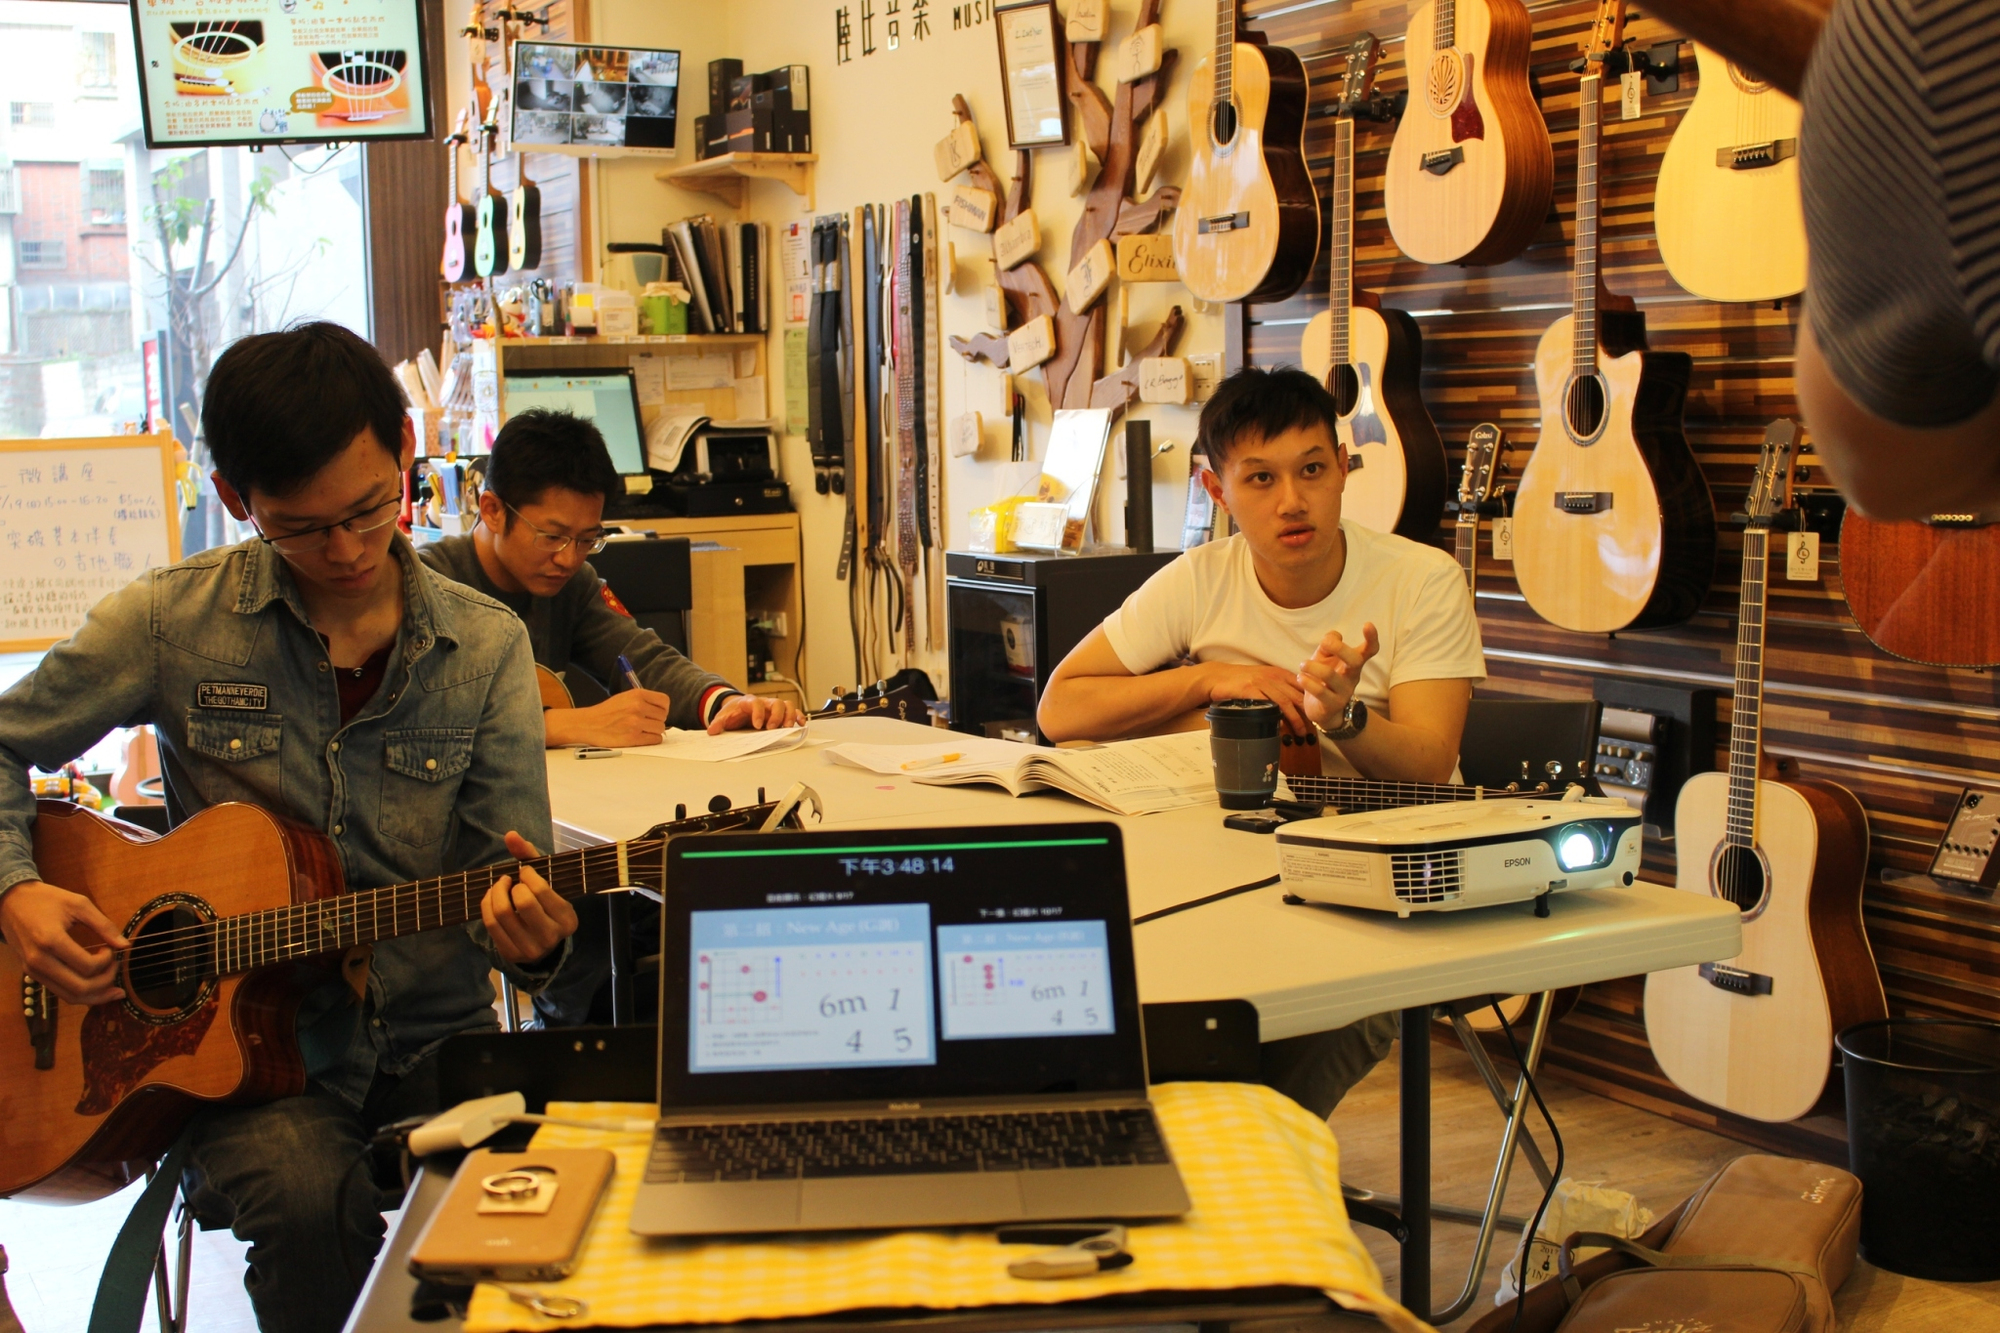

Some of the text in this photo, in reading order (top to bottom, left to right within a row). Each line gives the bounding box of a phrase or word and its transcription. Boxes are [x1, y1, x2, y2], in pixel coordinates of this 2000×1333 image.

[953, 0, 996, 31] MUSI
[953, 195, 987, 222] FISHMAN
[1504, 857, 1531, 868] EPSON
[819, 987, 901, 1019] 6m 1
[1030, 984, 1067, 1003] 6m
[1051, 1006, 1099, 1027] 4 5
[845, 1028, 864, 1054] 4
[893, 1027, 913, 1054] 5
